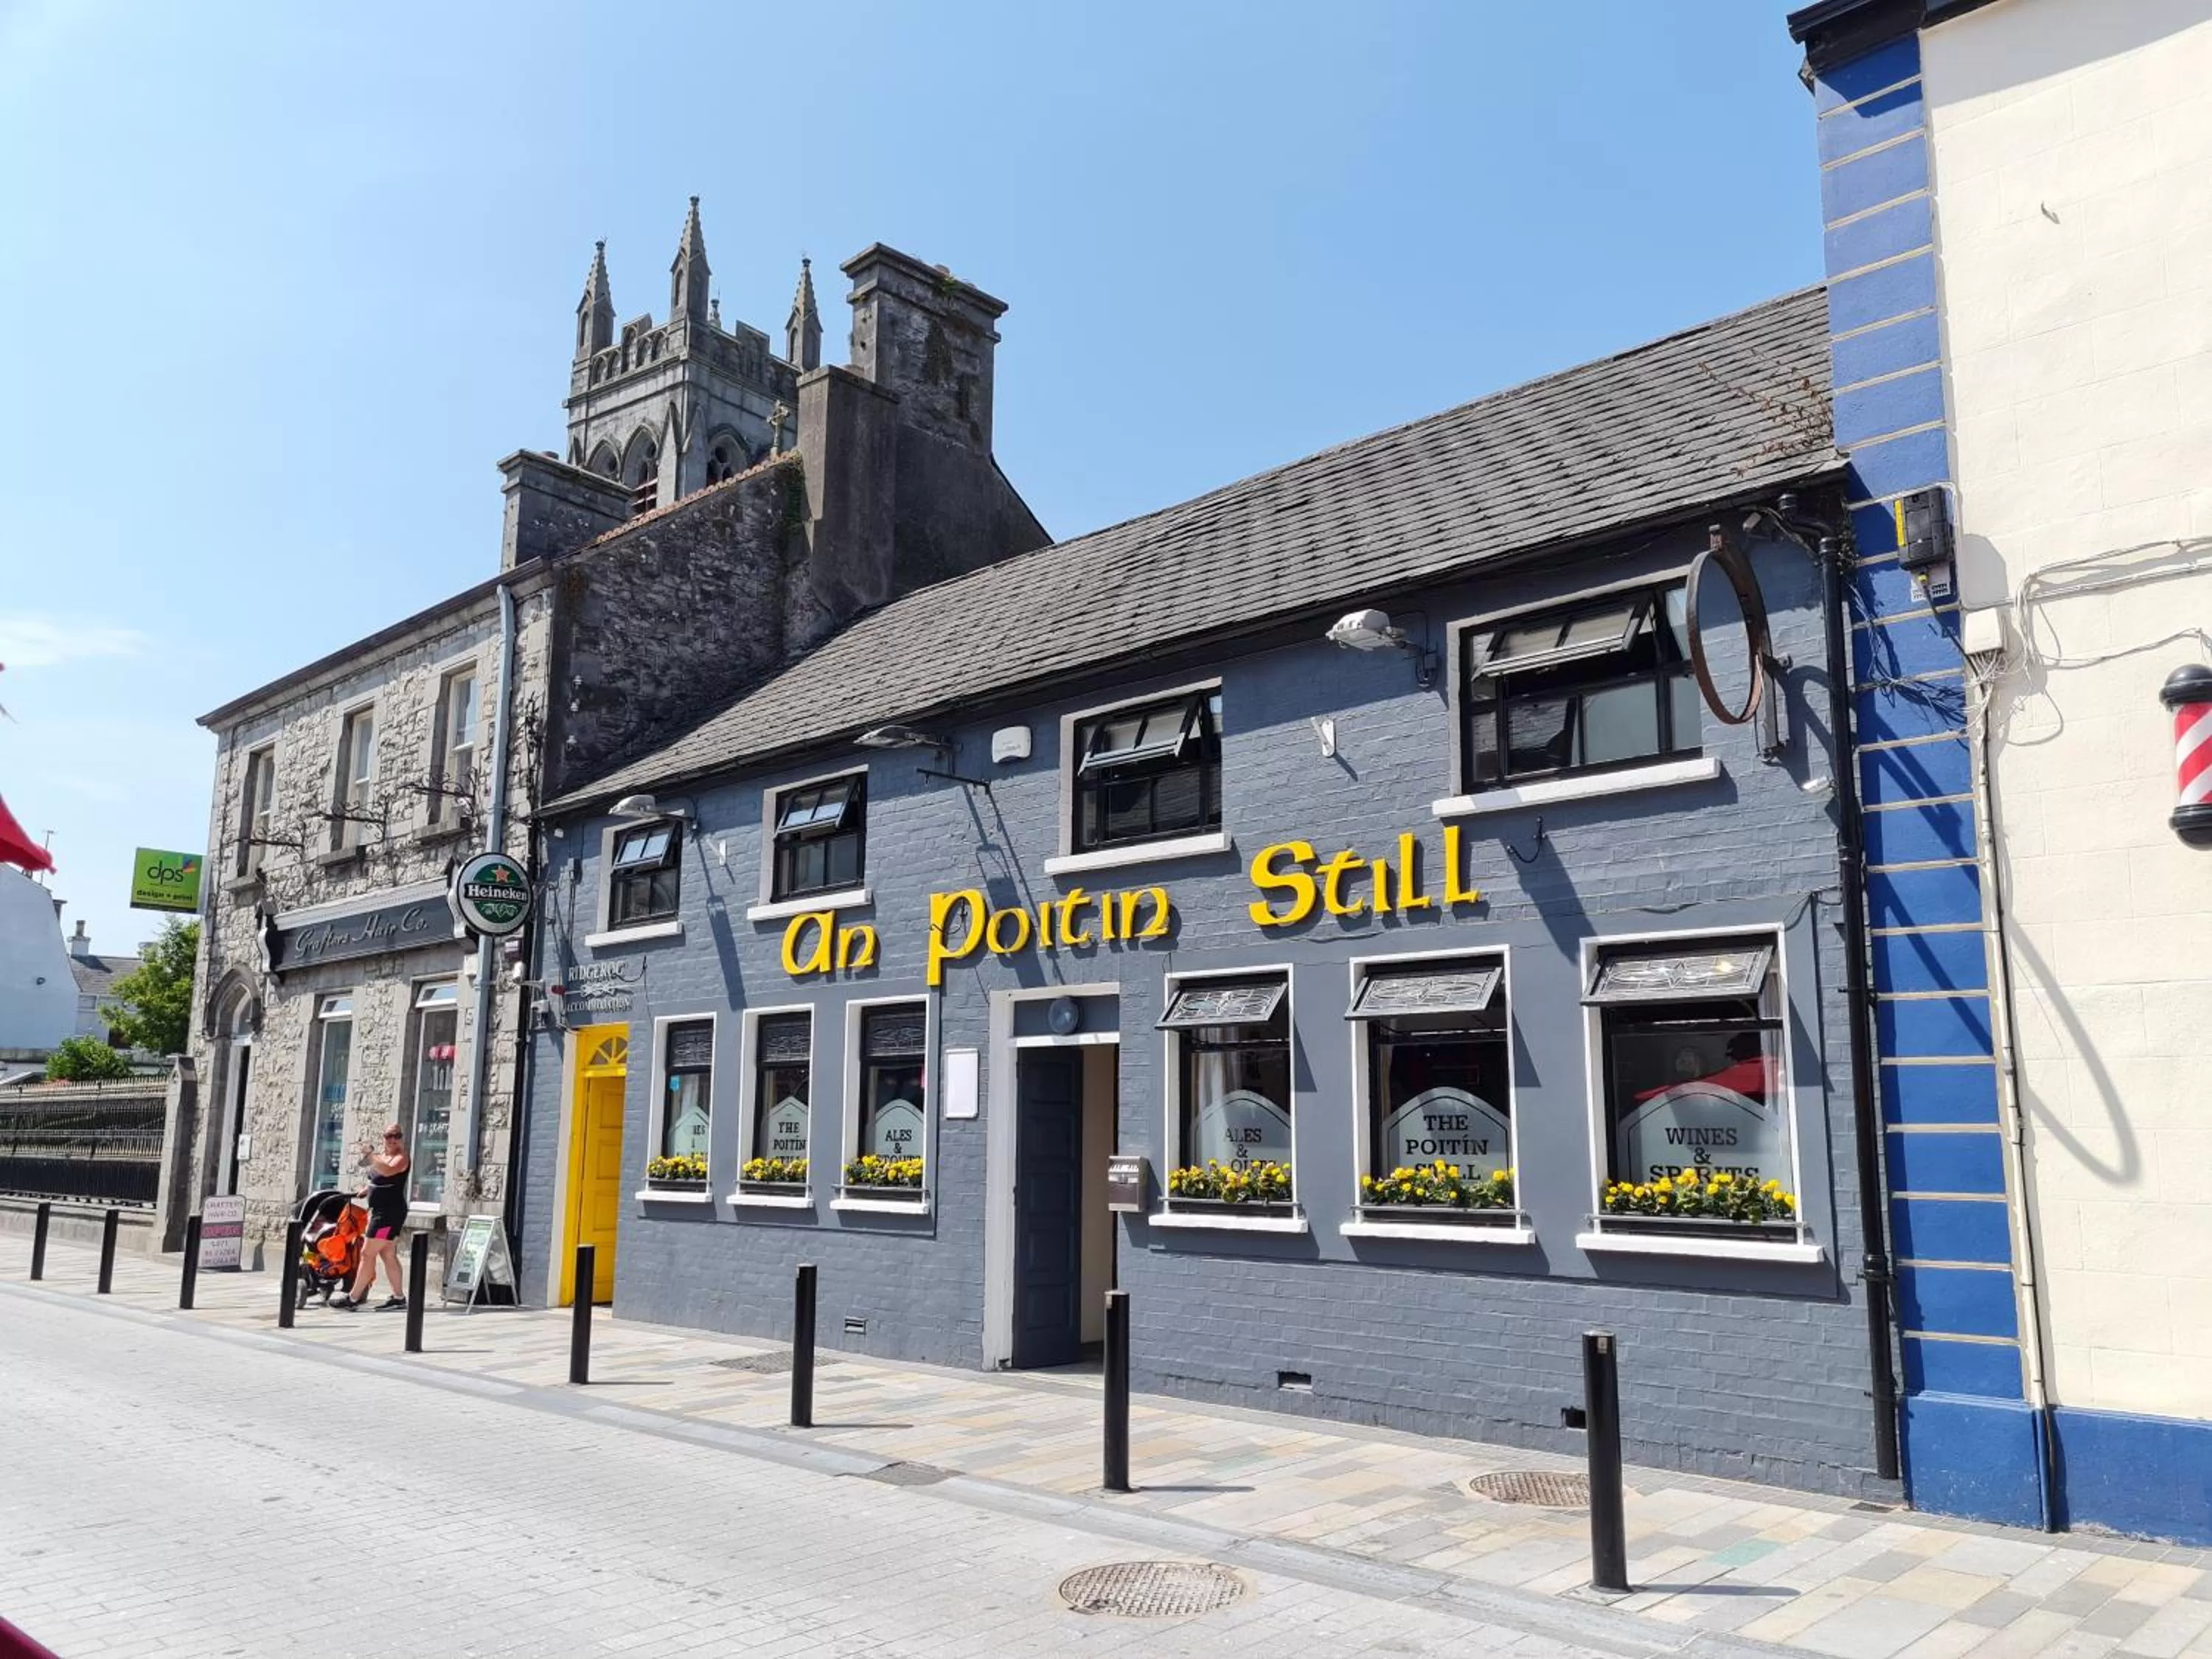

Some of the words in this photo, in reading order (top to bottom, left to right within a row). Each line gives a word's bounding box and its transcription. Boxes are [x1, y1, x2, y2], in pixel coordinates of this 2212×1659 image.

[147, 860, 184, 885] dps
[1248, 825, 1481, 926] Still
[467, 884, 528, 901] Heineken
[352, 914, 397, 942] Hair
[779, 1121, 800, 1133] THE
[1424, 1114, 1469, 1130] THE
[885, 1129, 912, 1141] ALES
[1224, 1127, 1262, 1142] ALES
[1665, 1127, 1738, 1145] WINES
[894, 1142, 902, 1153] &
[1237, 1144, 1248, 1158] &
[1405, 1134, 1489, 1155] POITÍN
[1694, 1147, 1712, 1164] &
